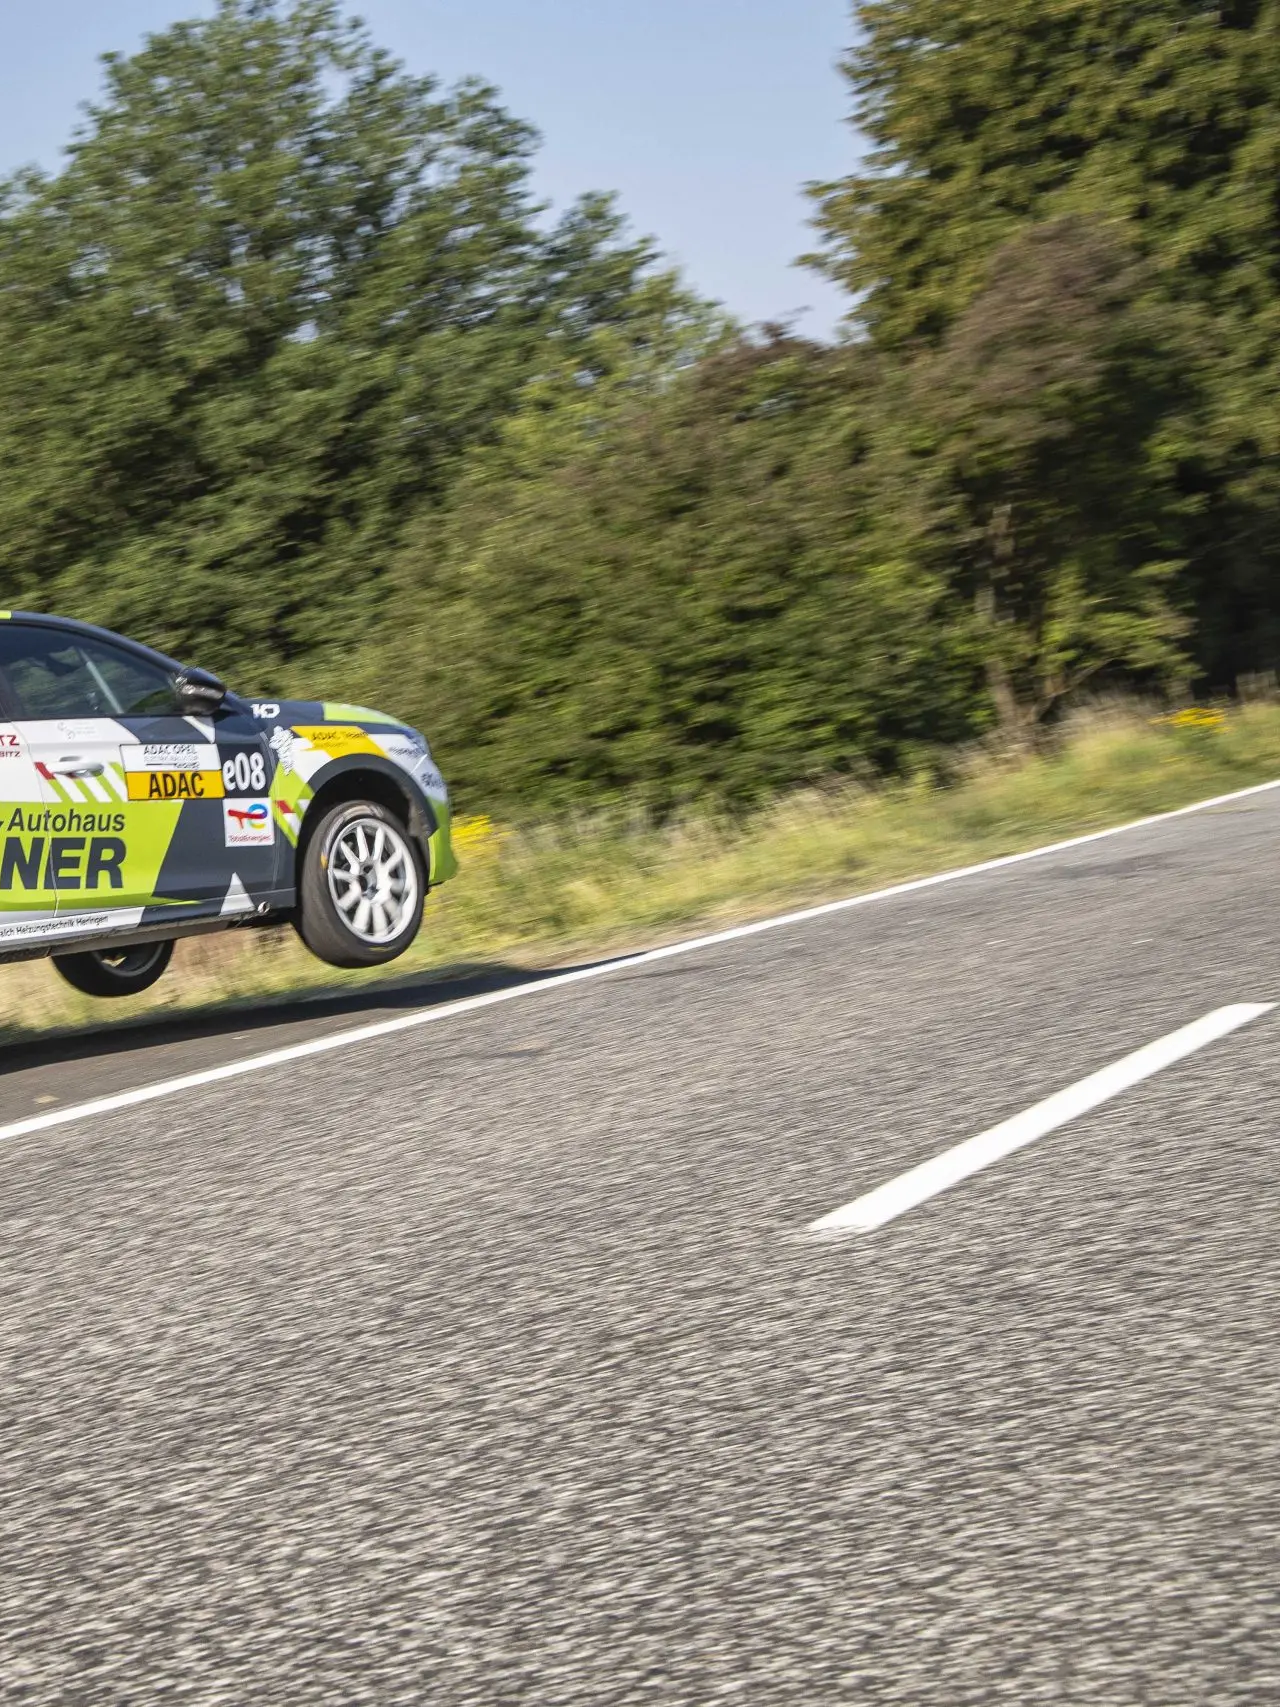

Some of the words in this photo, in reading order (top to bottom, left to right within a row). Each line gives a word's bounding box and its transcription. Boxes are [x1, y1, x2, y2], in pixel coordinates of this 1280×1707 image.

[222, 752, 266, 791] e08
[148, 773, 205, 798] ADAC
[7, 807, 126, 832] Autohaus
